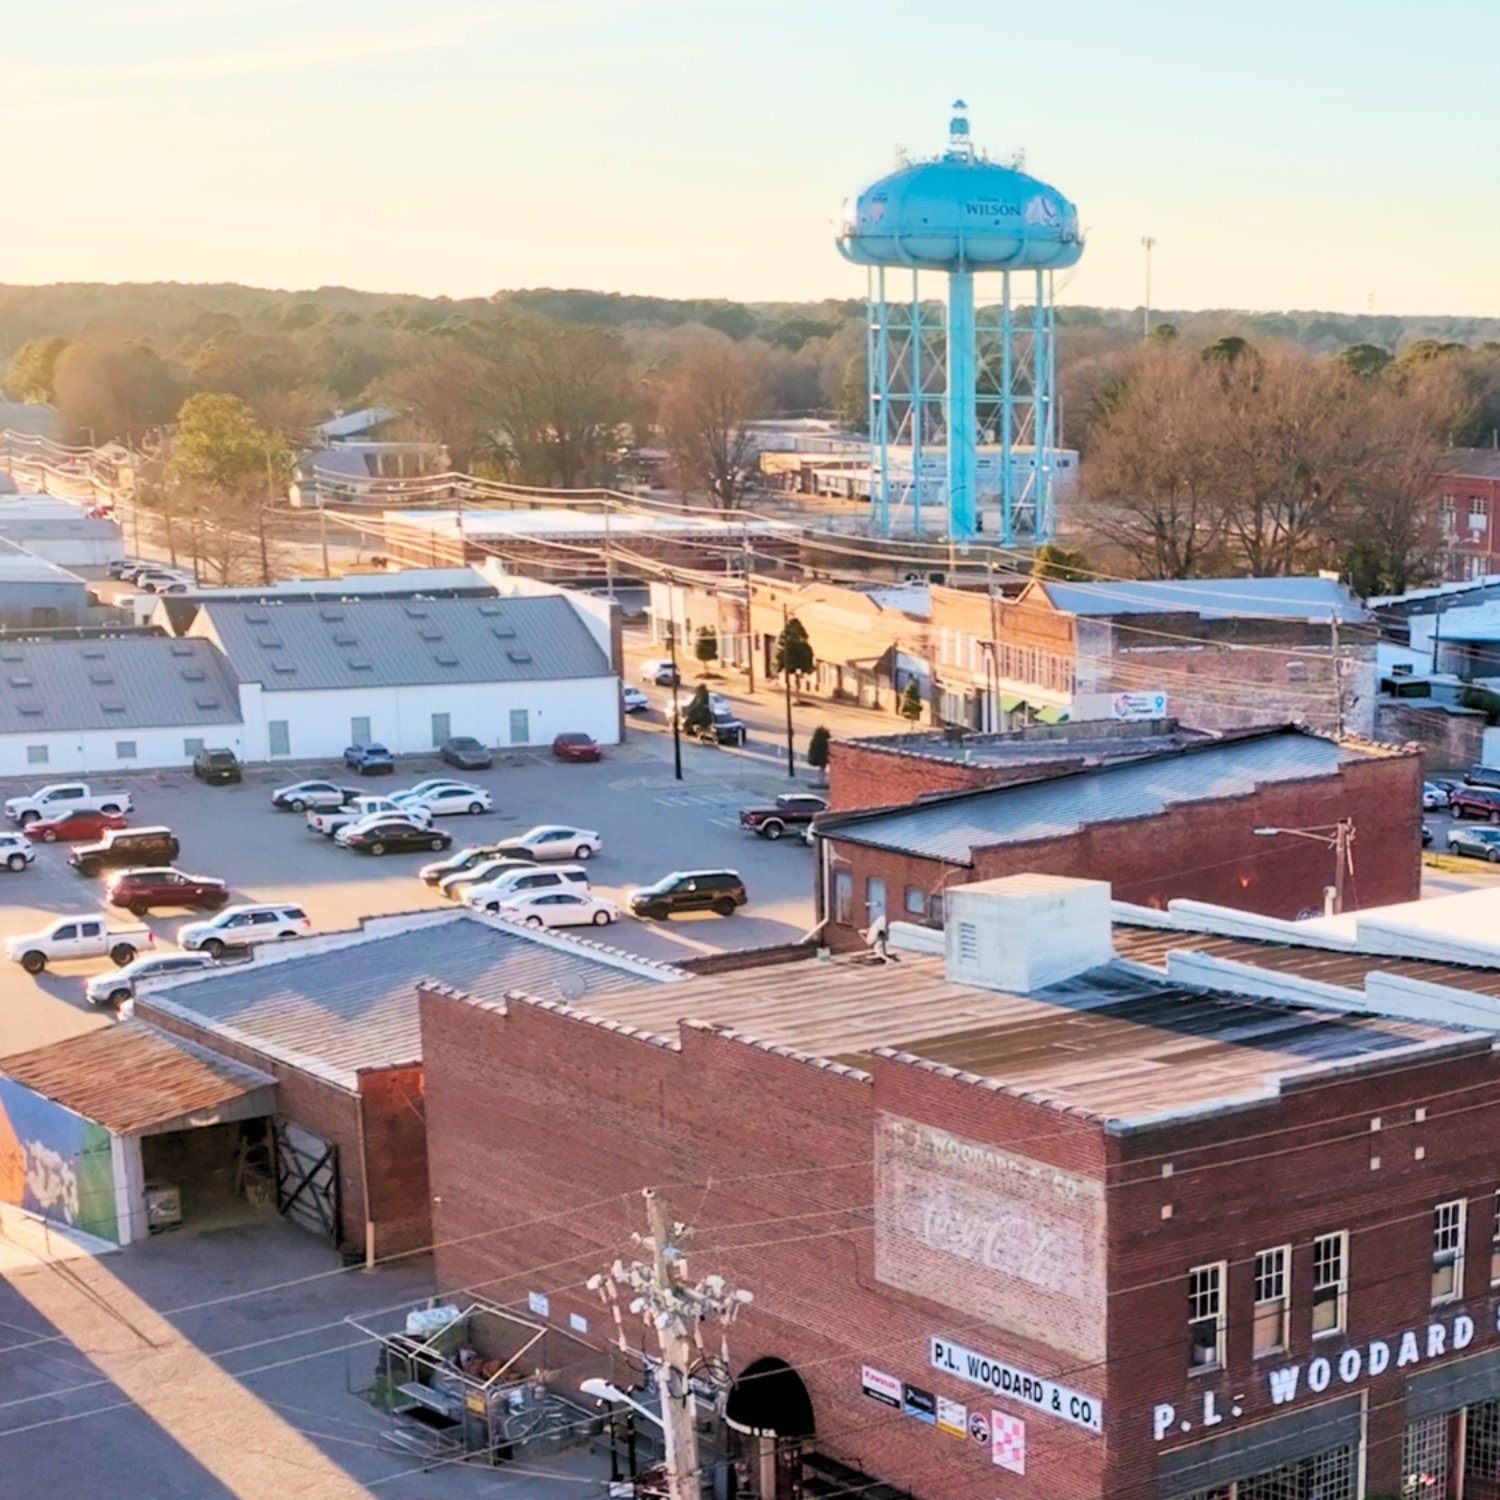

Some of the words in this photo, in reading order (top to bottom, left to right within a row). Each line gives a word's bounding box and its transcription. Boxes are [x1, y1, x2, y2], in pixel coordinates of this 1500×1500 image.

[965, 203, 1021, 217] WILSON
[935, 1343, 960, 1371] P.L.
[967, 1355, 1043, 1403] WOODARD
[1051, 1389, 1062, 1412] &
[1070, 1397, 1098, 1427] CO.
[1269, 1315, 1474, 1404] WOODARD
